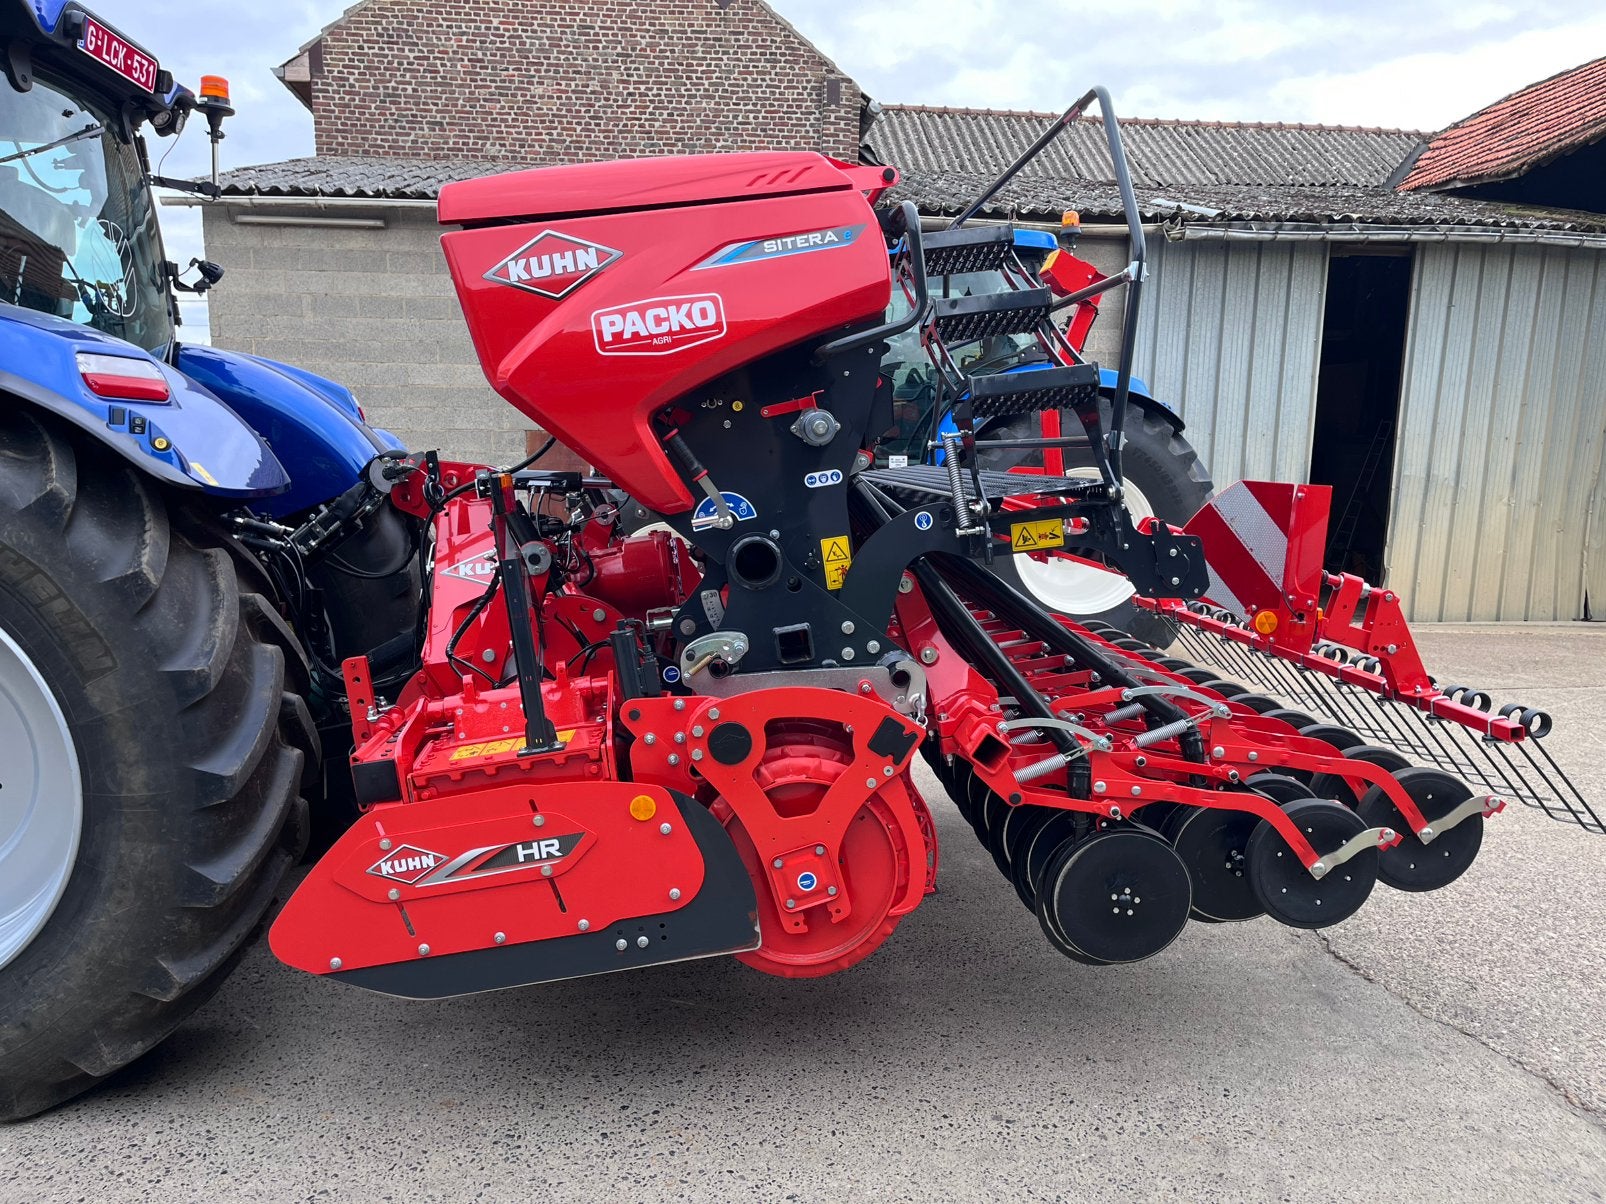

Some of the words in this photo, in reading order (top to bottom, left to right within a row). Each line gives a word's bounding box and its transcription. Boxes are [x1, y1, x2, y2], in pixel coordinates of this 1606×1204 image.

[763, 230, 839, 252] SITERA
[507, 246, 600, 284] KUHN
[600, 301, 717, 341] PACKO
[652, 335, 672, 346] AGRI
[459, 562, 497, 577] KU
[516, 838, 563, 862] HR
[380, 853, 436, 875] KUHN
